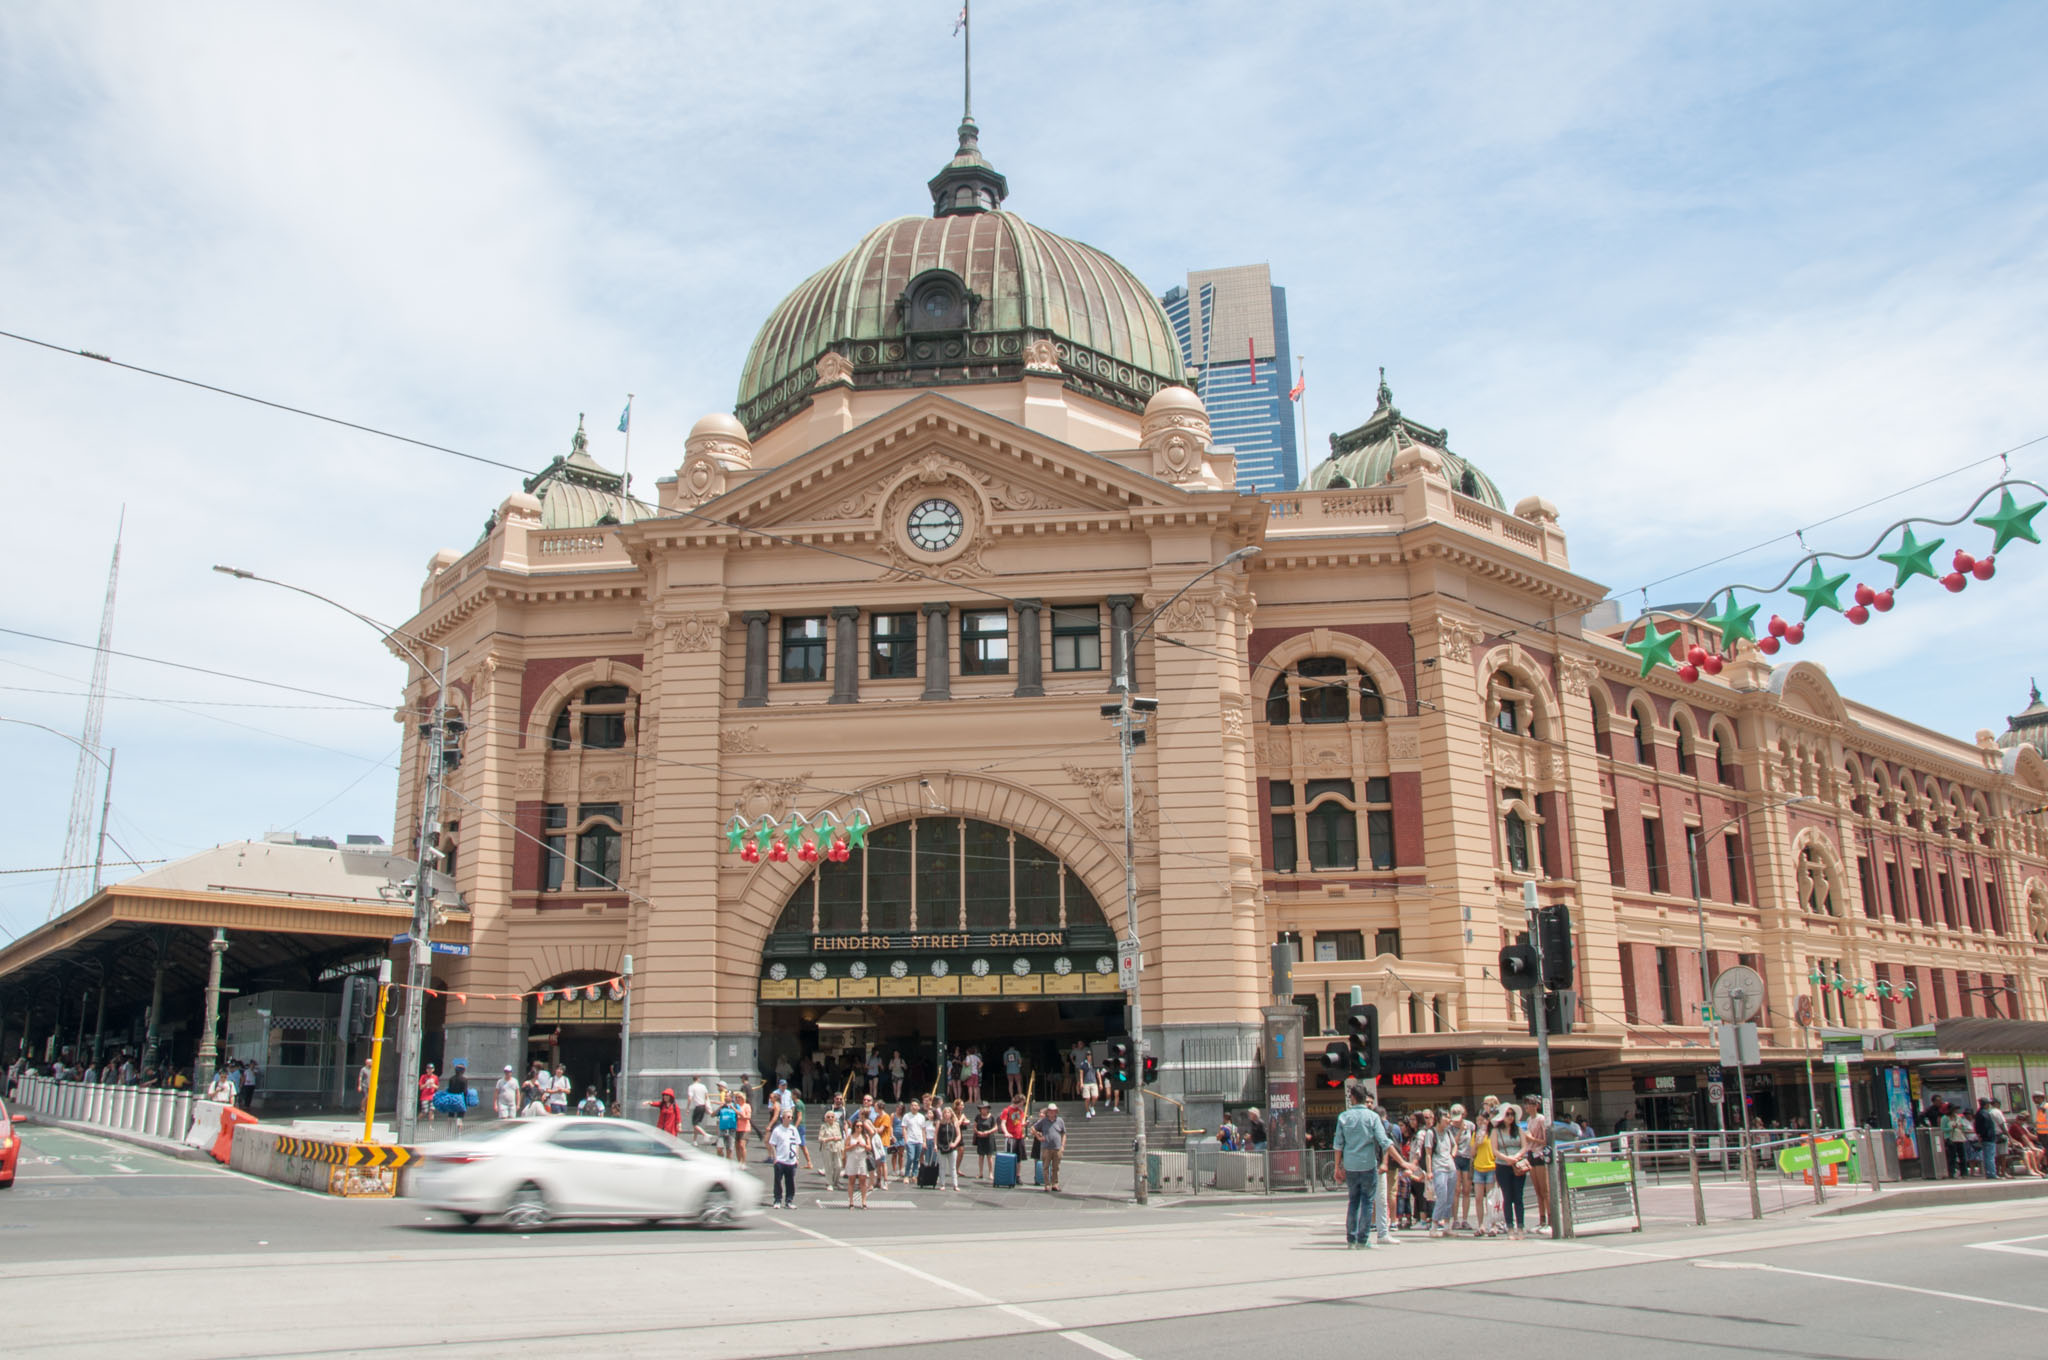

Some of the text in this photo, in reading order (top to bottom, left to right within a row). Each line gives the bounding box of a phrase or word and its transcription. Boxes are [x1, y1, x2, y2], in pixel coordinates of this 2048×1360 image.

[814, 932, 1063, 950] FLINDERS STREET STATION
[1392, 1073, 1440, 1086] HATTERS
[1270, 1094, 1291, 1102] MAKE
[1270, 1101, 1295, 1109] MERRY
